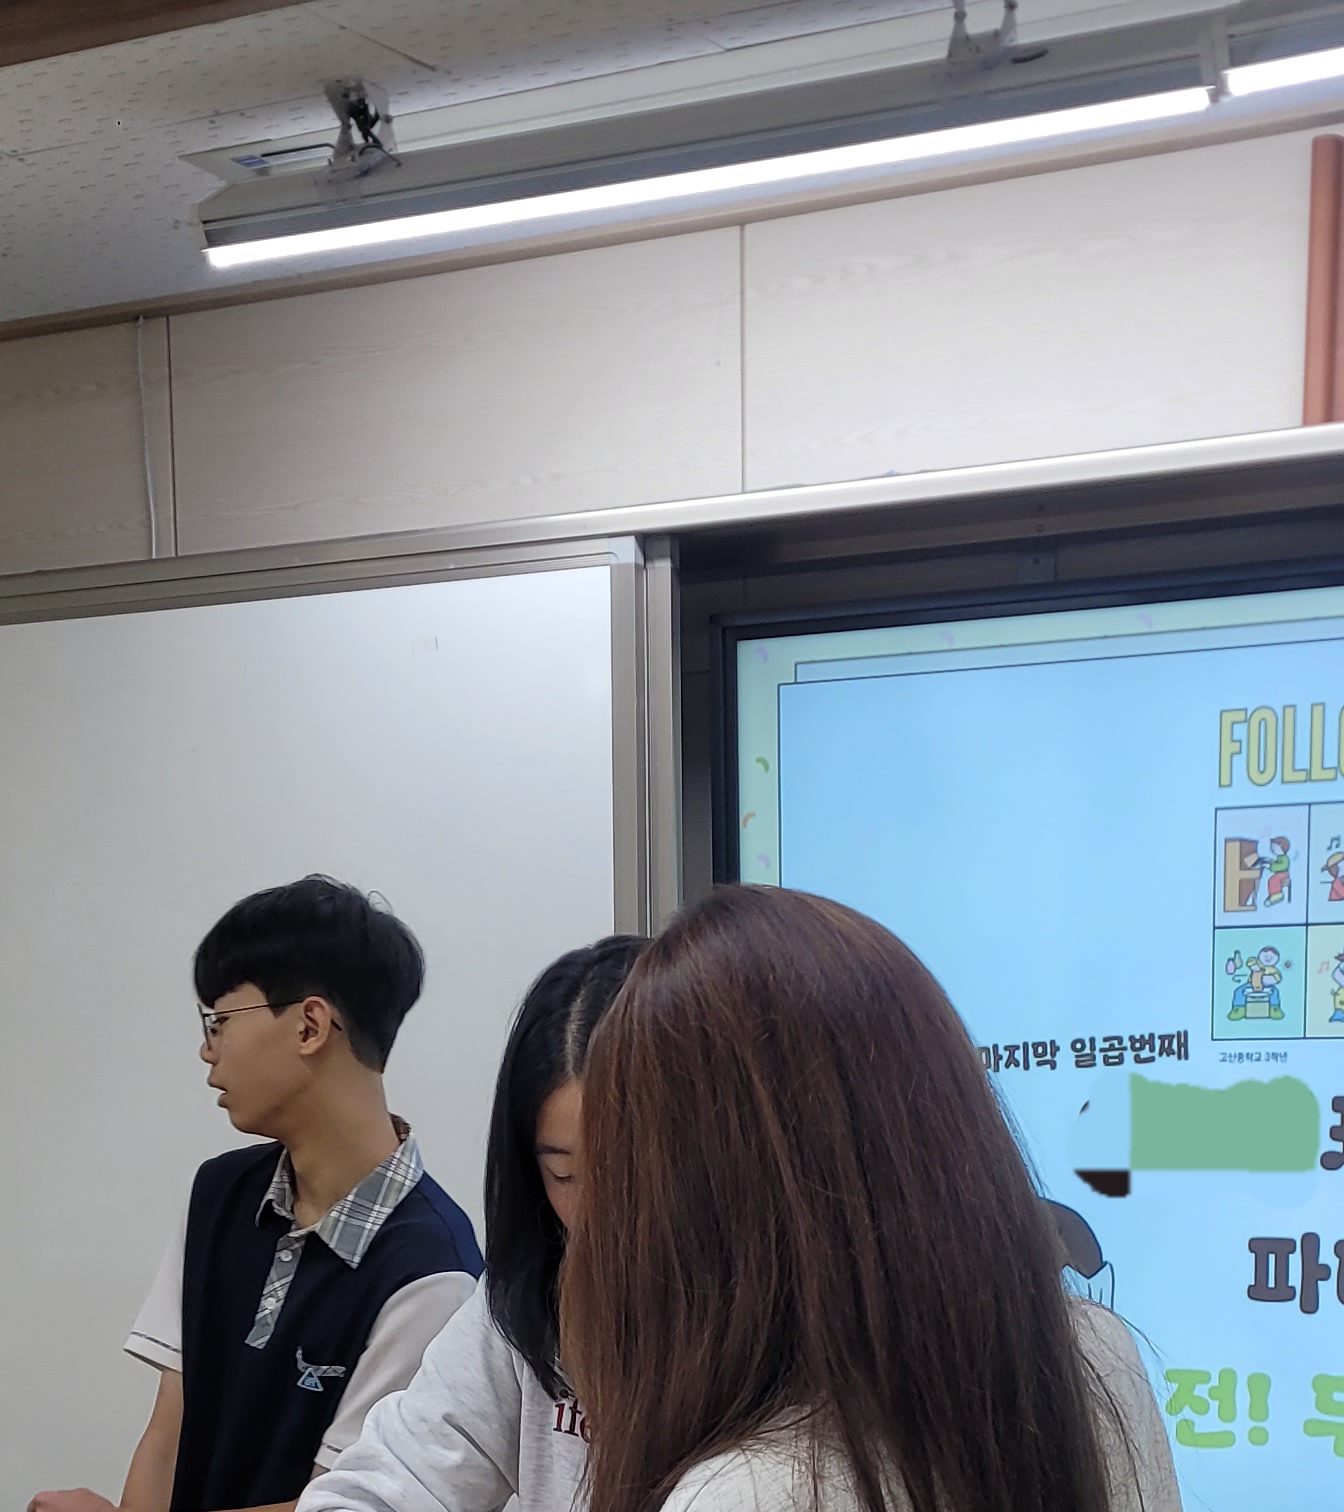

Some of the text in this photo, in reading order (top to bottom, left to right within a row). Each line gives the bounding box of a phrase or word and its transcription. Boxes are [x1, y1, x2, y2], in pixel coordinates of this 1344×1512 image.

[979, 1030, 1190, 1073] 마지막 일곱번째
[1164, 1367, 1271, 1449] 전!
